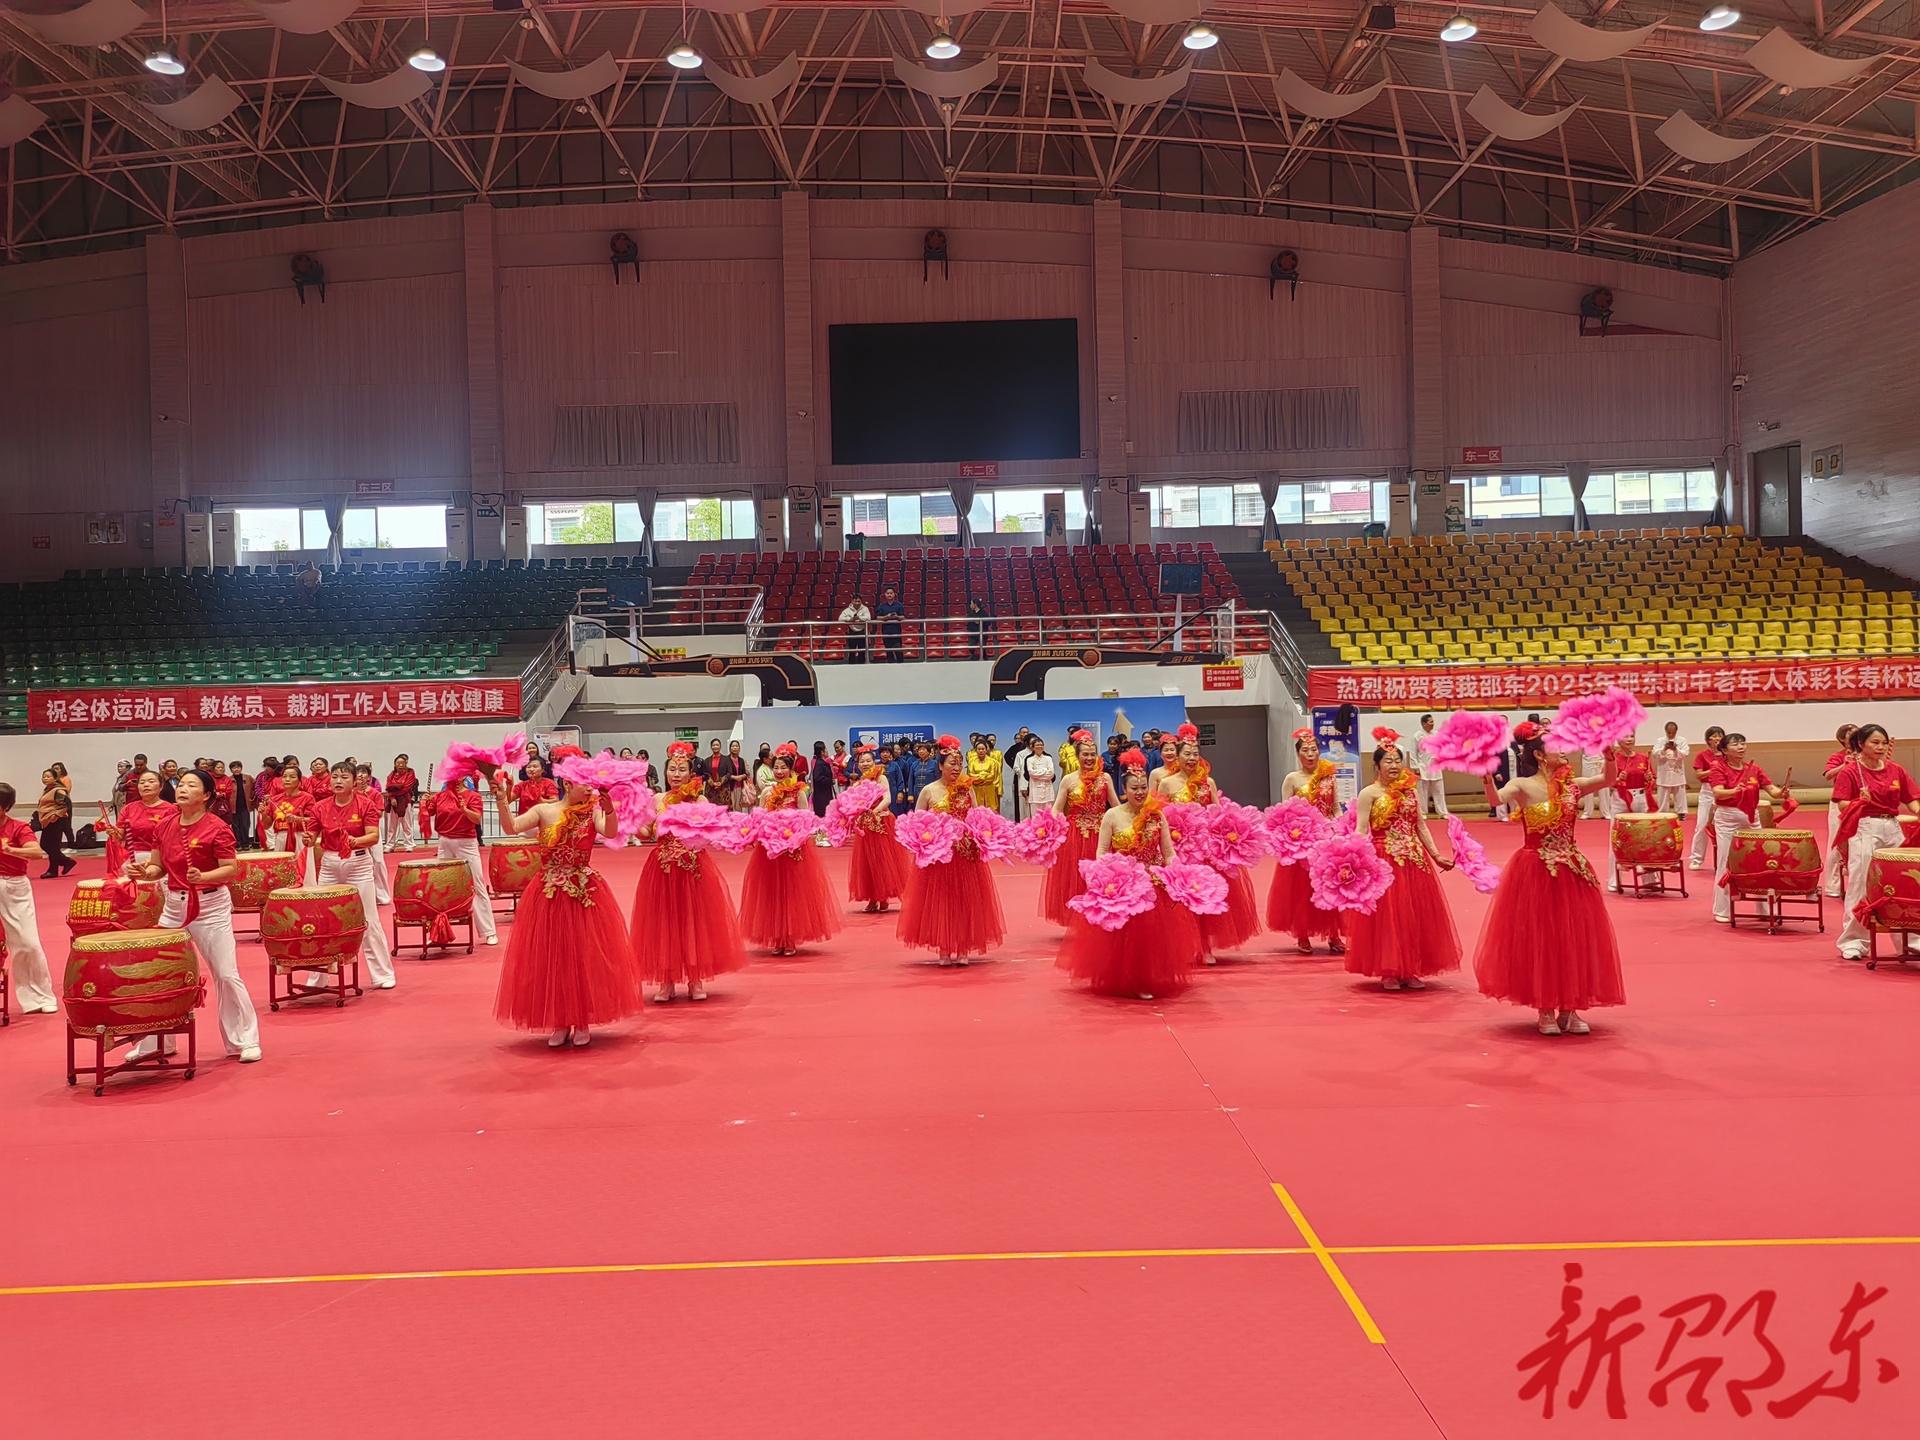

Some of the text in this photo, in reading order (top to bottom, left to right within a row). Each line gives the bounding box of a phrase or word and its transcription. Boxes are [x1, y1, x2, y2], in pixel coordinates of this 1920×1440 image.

[1465, 450, 1500, 461] 东一区
[962, 464, 997, 476] 东二区
[358, 482, 392, 493] 东三区
[46, 688, 505, 722] 祝全体运动员、教练员、裁判工作人员身体健康
